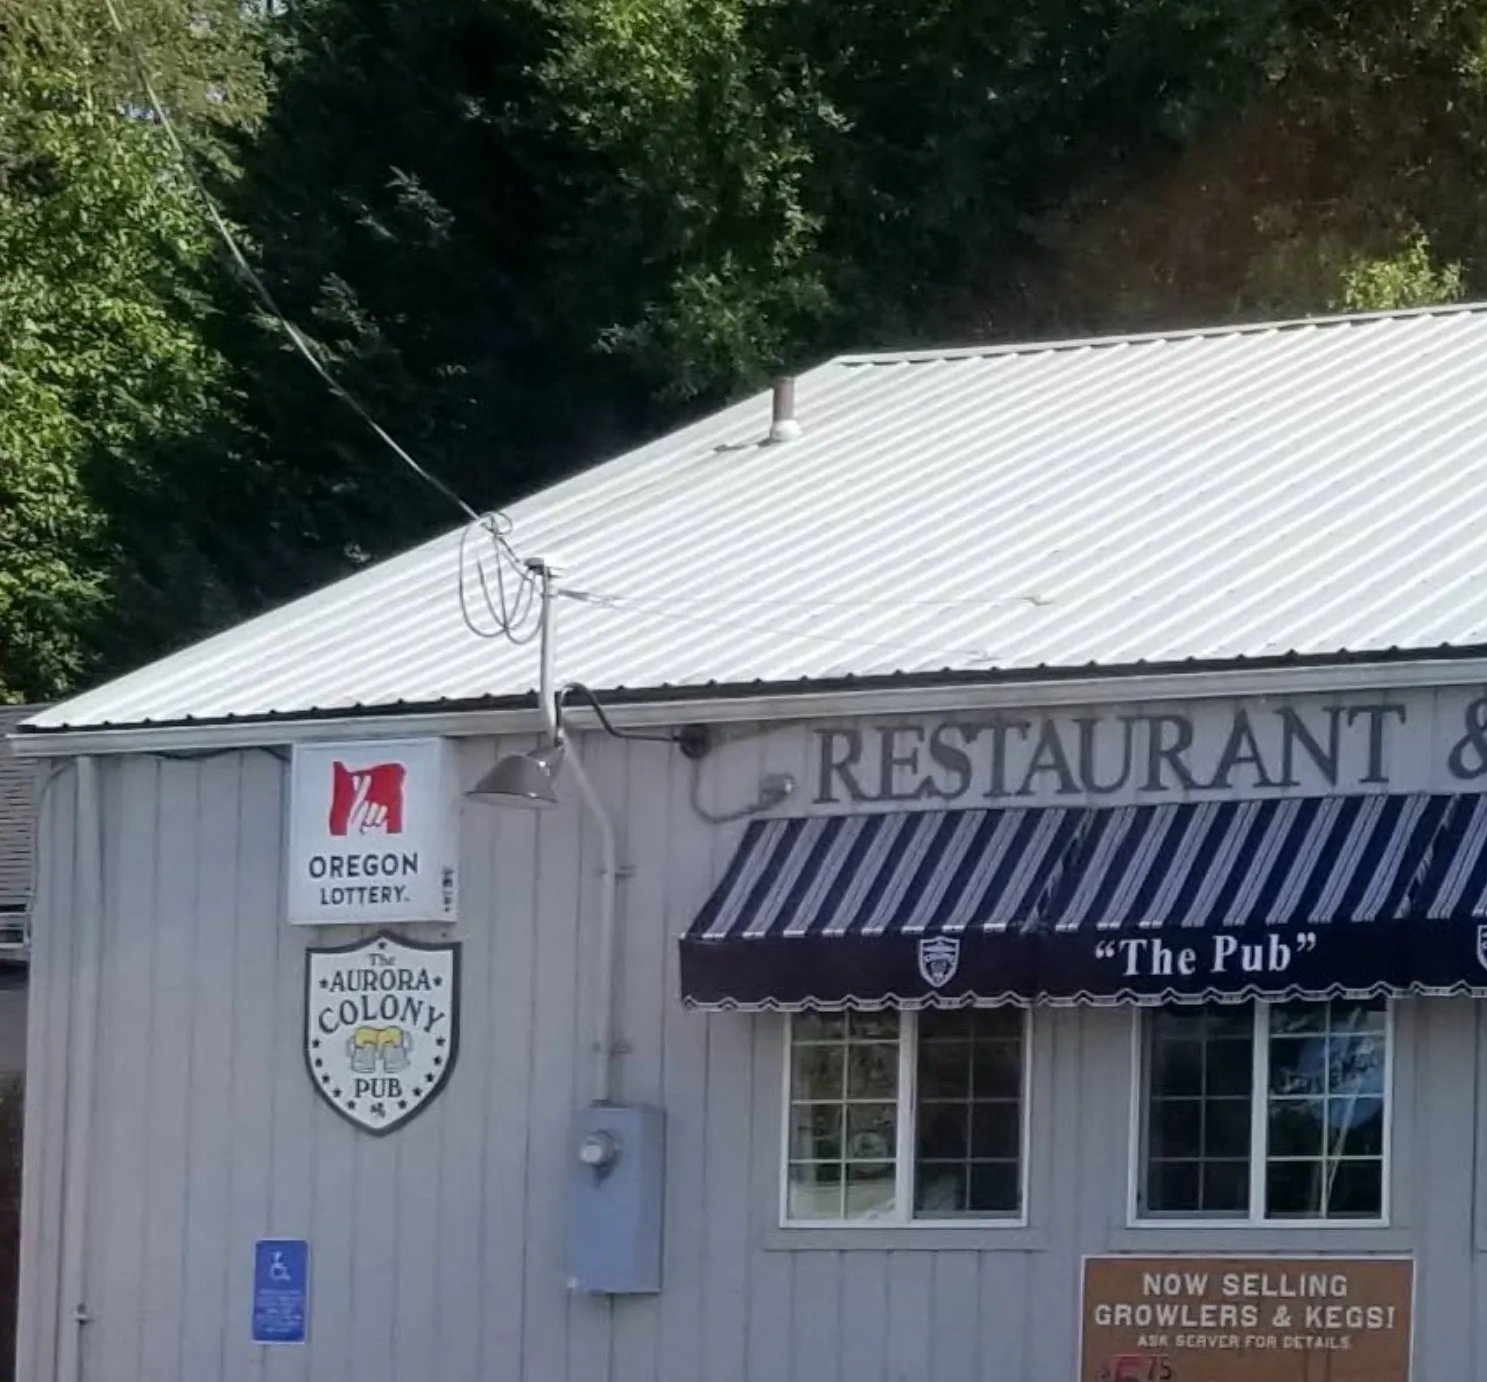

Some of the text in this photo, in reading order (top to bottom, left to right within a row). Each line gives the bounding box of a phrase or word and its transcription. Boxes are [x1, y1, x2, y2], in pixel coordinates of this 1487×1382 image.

[811, 703, 1407, 804] RESTAURANT
[308, 852, 419, 878] OREGON
[368, 952, 397, 967] The
[1094, 931, 1318, 976] “The Pub”
[328, 967, 433, 993] AURORA
[317, 993, 446, 1035] COLONY
[353, 1077, 403, 1099] PUB
[1142, 1272, 1349, 1298] NOW SELLING
[1094, 1302, 1396, 1330] GROWLERS & KEGS!
[1136, 1334, 1352, 1351] ASK SERVER FOR DETAILS
